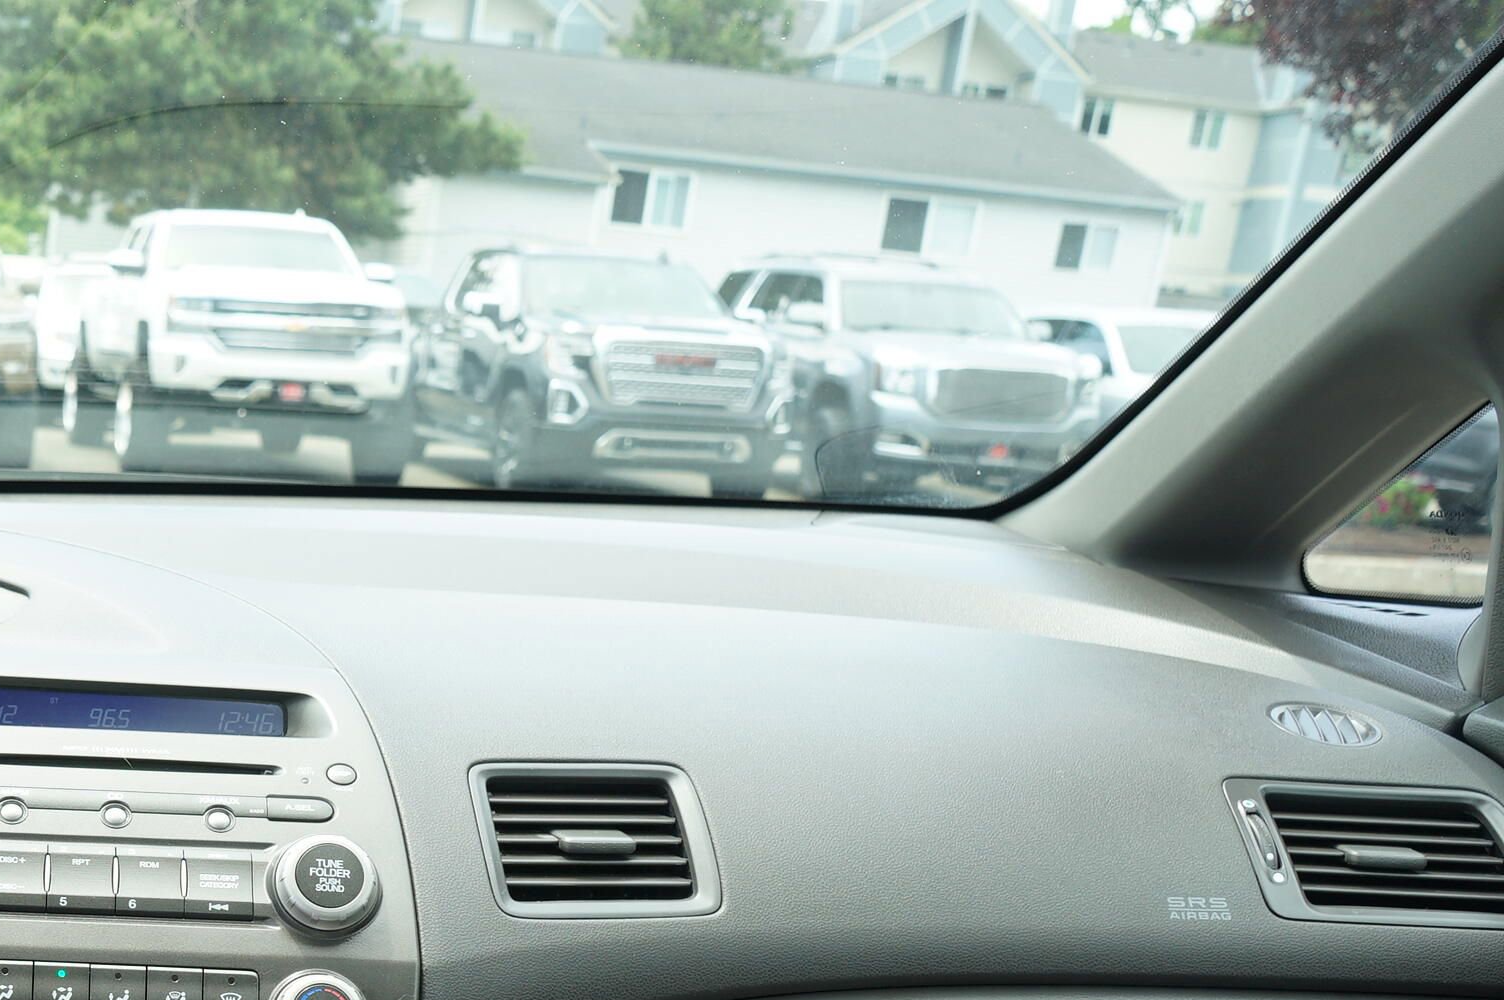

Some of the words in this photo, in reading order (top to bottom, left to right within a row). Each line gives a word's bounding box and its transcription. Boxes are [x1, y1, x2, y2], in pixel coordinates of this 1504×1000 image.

[218, 711, 274, 735] 12:46
[71, 858, 90, 866] RPT
[139, 861, 160, 869] RDM
[315, 858, 344, 869] TUNE
[309, 867, 351, 879] FOLDER
[319, 877, 341, 885] PUSH
[315, 884, 345, 893] SOUND
[59, 896, 68, 907] 5
[128, 899, 137, 909] 6
[1167, 896, 1228, 908] SRS
[1170, 911, 1232, 921] AIRBAG
